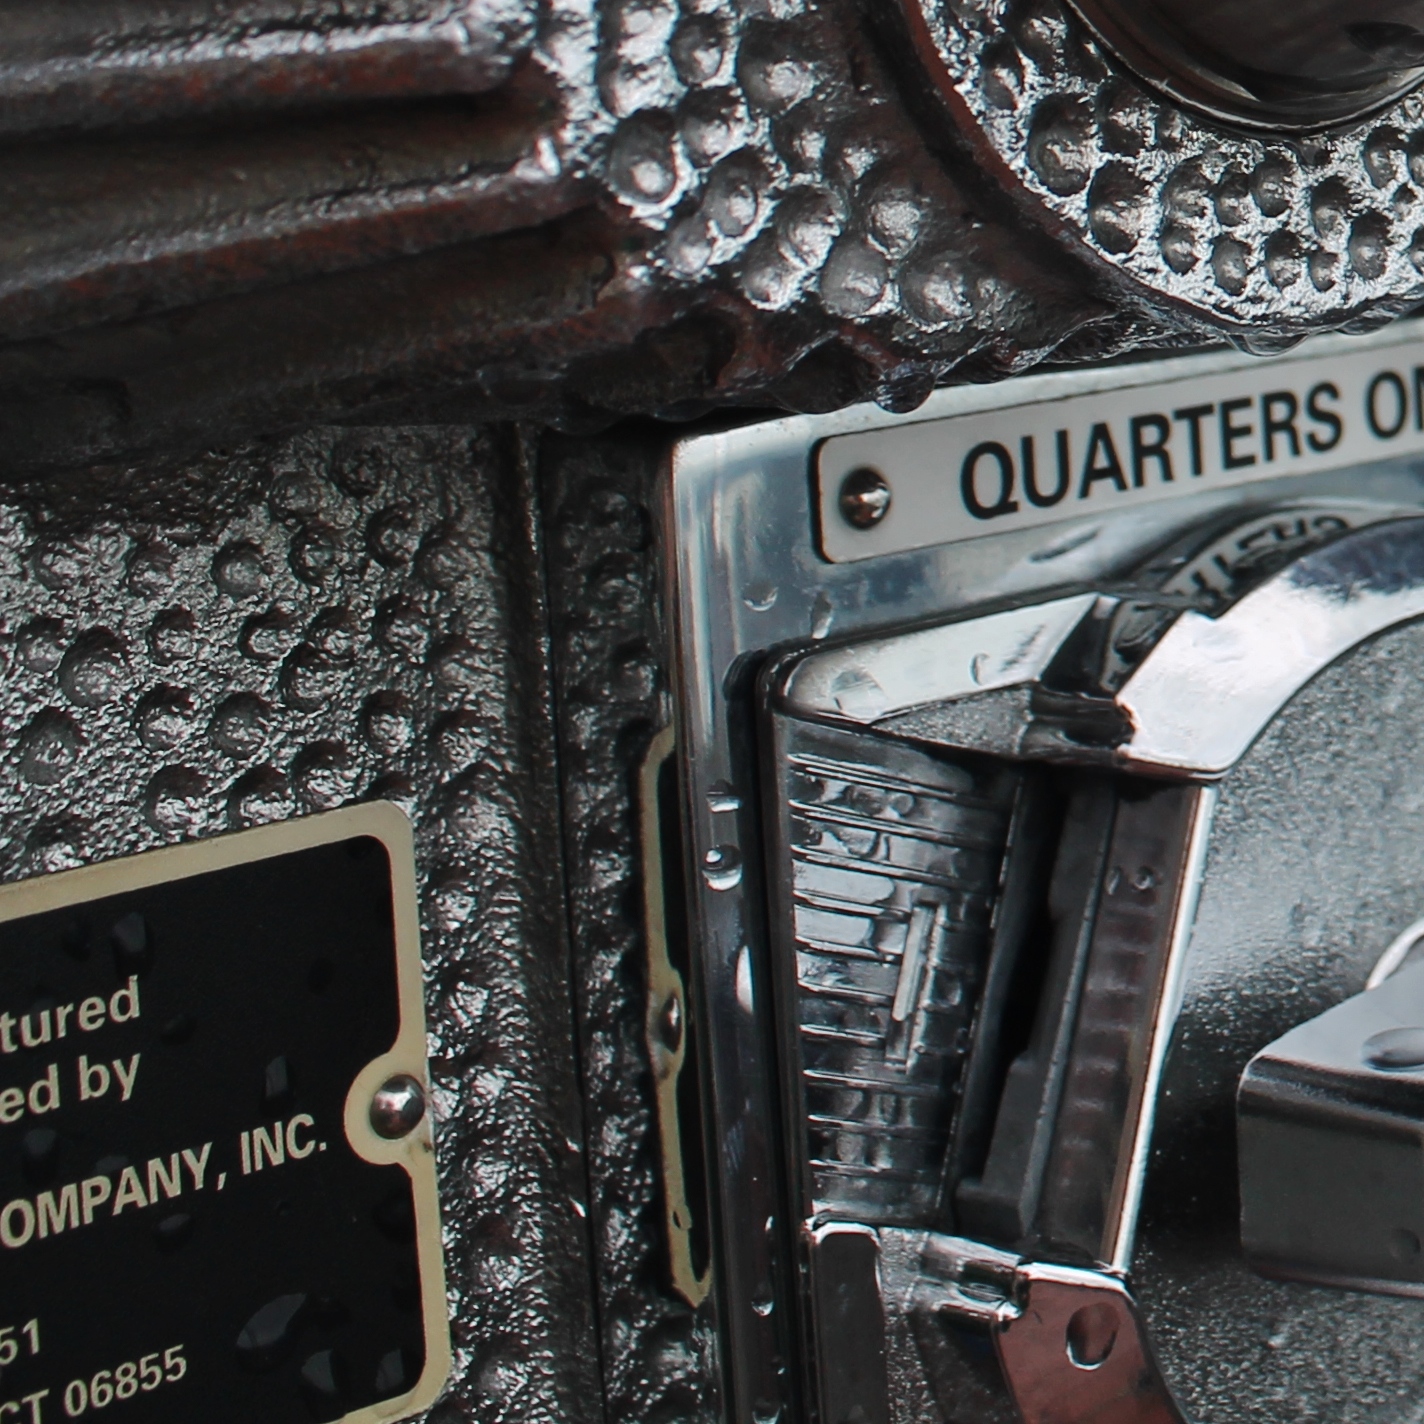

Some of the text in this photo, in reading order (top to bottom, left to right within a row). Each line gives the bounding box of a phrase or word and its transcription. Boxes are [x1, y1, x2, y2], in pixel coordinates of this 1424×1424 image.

[960, 382, 1344, 519] QUARTERS
[0, 974, 141, 1053] tured
[0, 1052, 141, 1123] ed by
[240, 1113, 327, 1175] INC.
[64, 1343, 188, 1417] 06855
